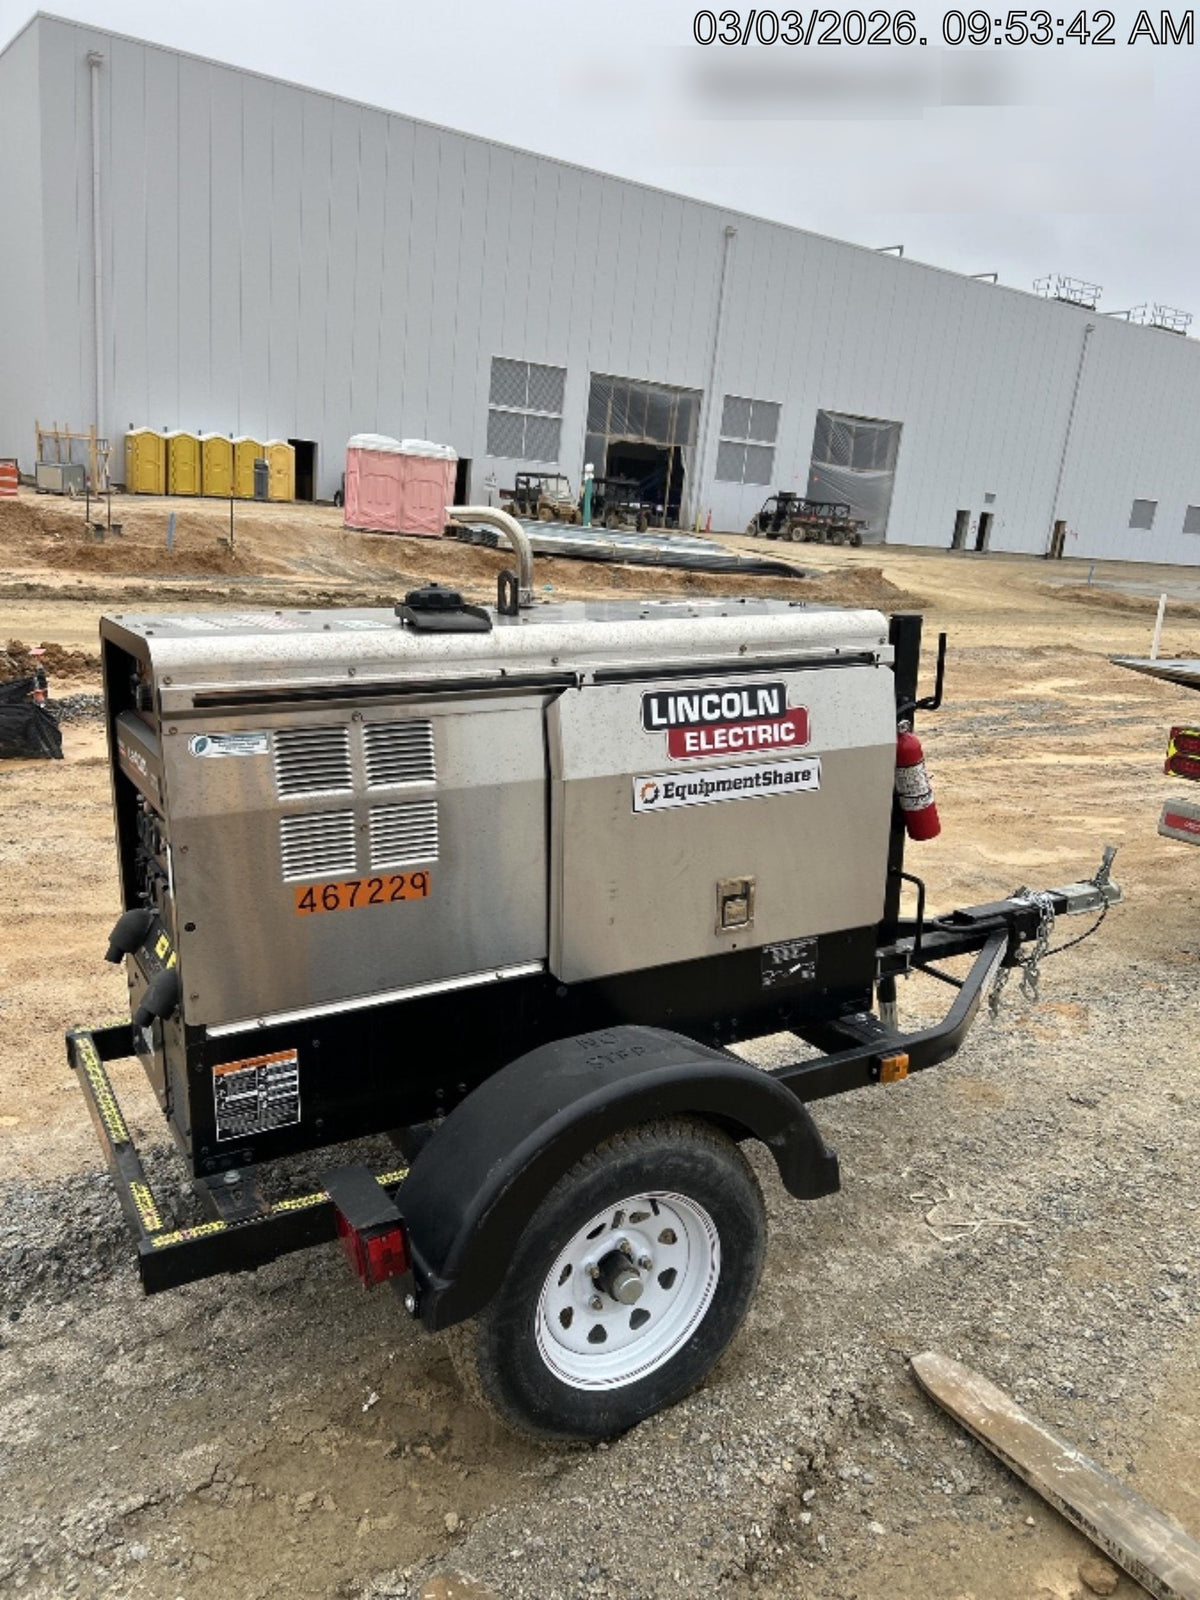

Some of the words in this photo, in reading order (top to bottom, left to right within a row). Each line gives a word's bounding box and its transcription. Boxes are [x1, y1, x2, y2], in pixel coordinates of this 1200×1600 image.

[650, 688, 780, 726] LINCOLN
[684, 722, 796, 752] ELECTRIC
[662, 768, 812, 799] EquipmentShare
[298, 871, 428, 912] 467229
